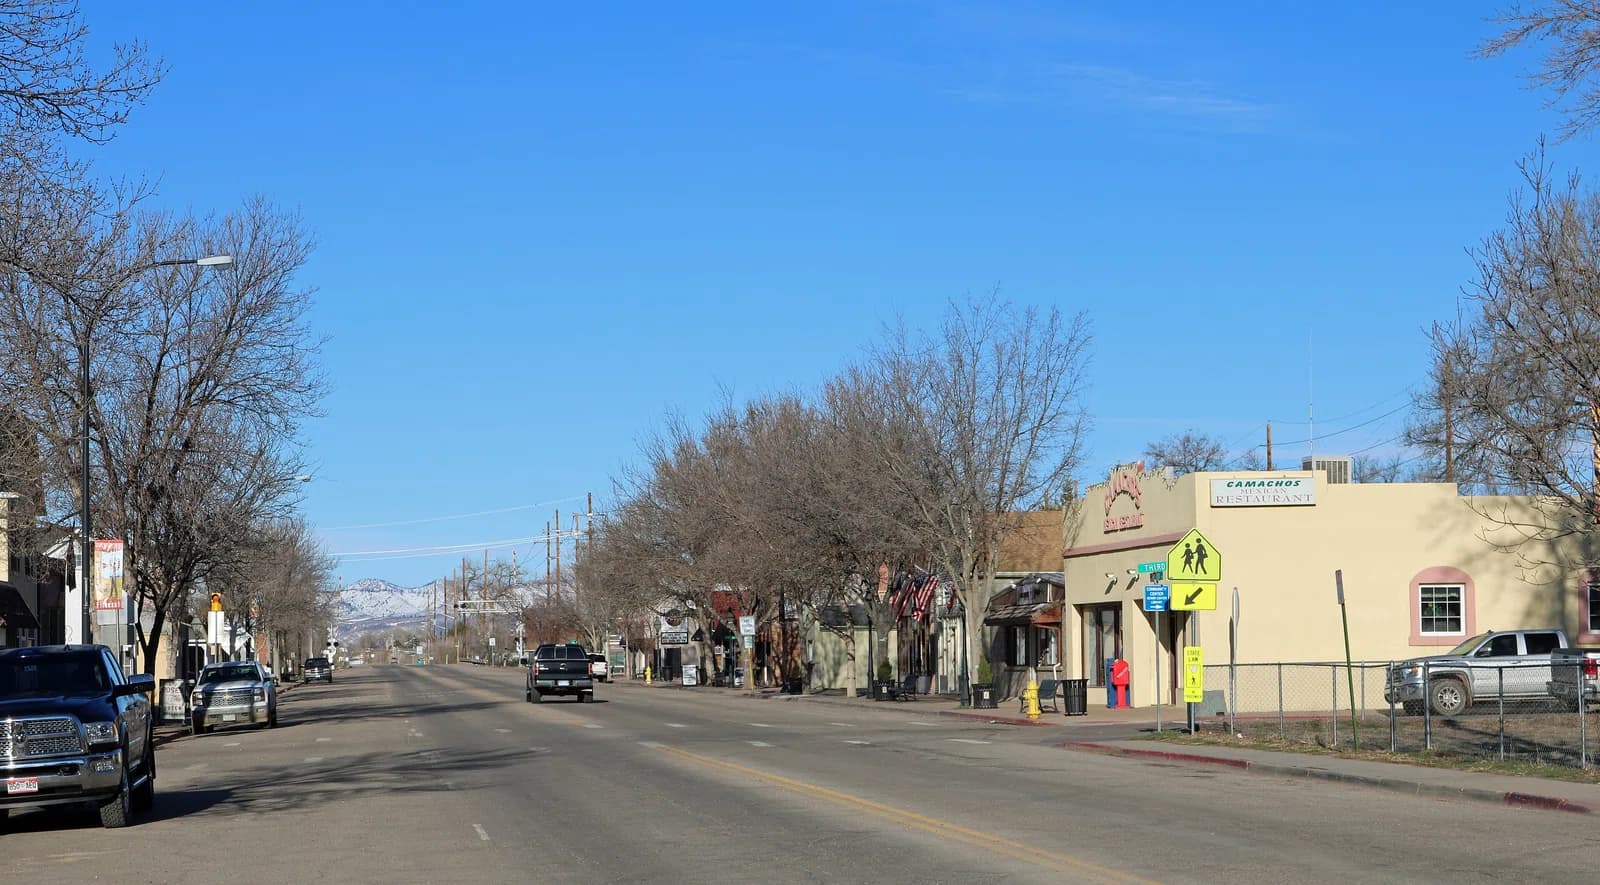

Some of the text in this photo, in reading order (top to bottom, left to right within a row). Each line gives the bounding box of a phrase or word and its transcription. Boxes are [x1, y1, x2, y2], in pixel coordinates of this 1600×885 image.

[1226, 480, 1301, 488] CAMACHOS
[1240, 487, 1287, 495] MEXICAN
[1216, 494, 1312, 504] RESTAURANT
[1143, 563, 1166, 572] THIRD
